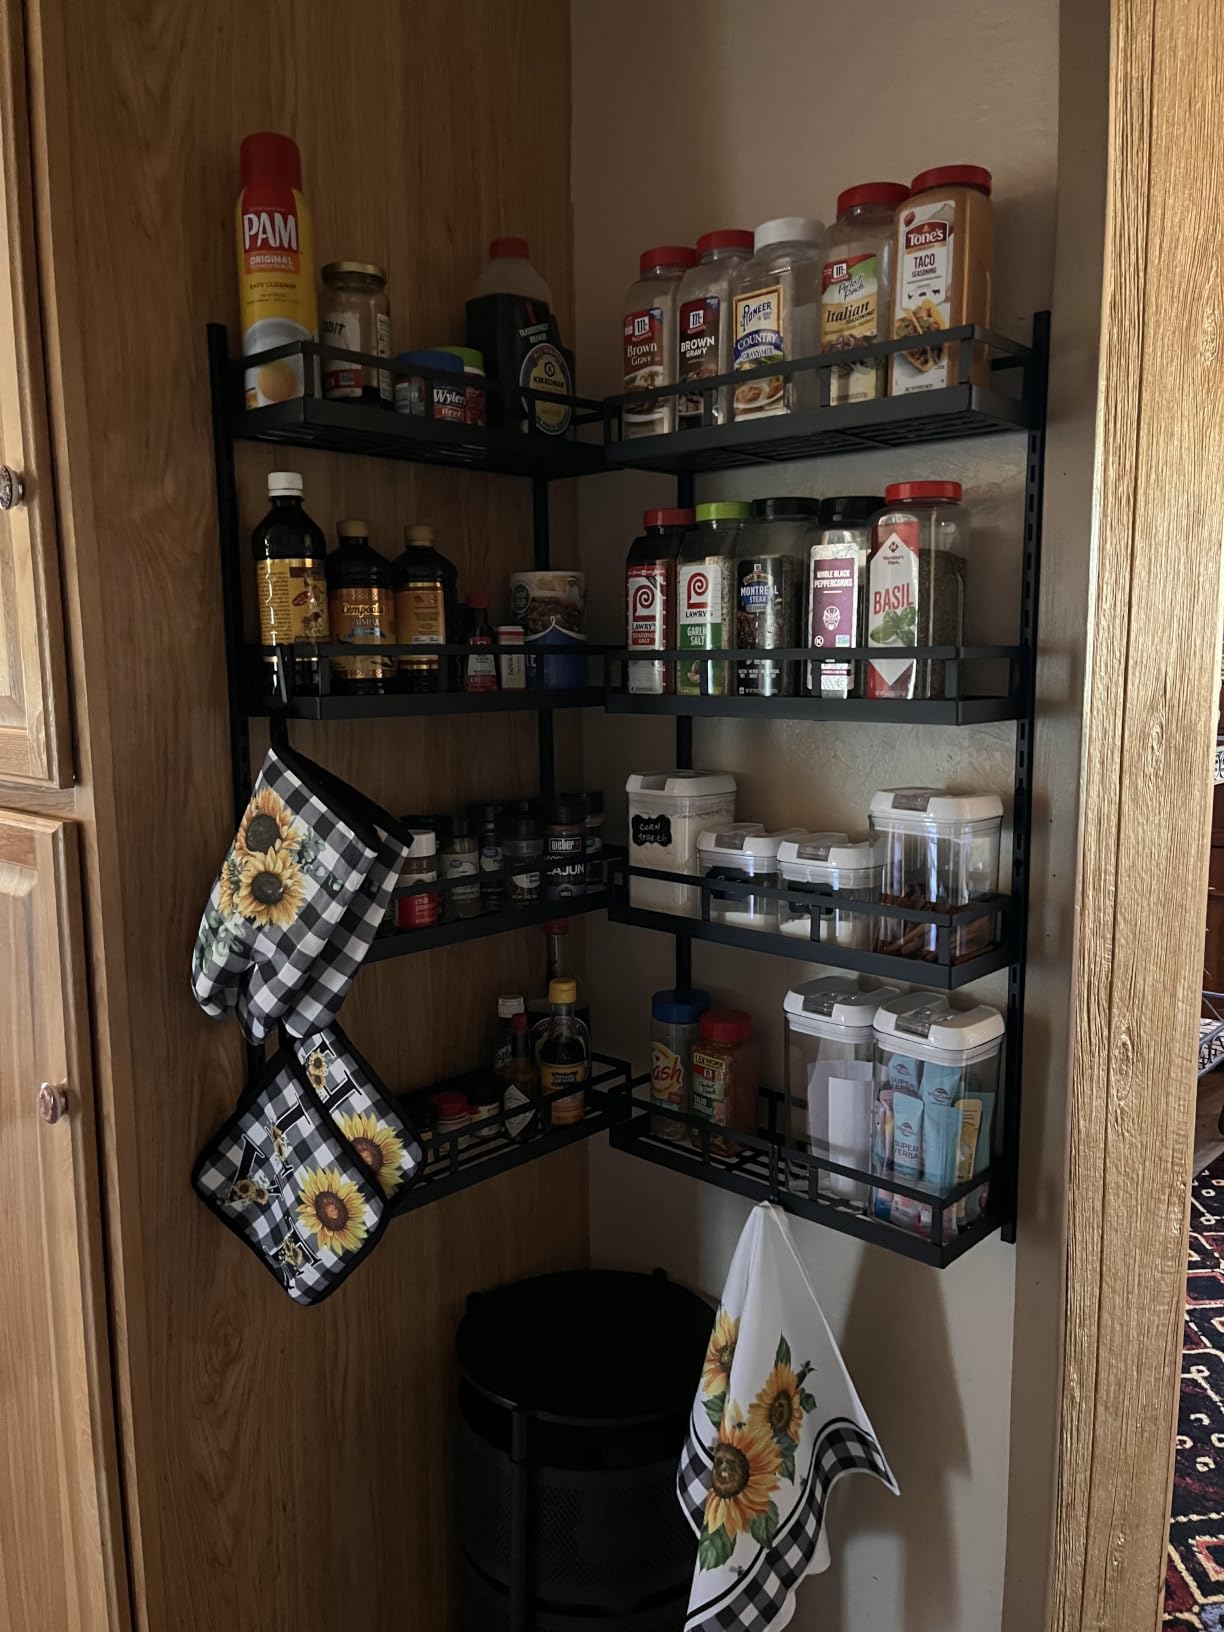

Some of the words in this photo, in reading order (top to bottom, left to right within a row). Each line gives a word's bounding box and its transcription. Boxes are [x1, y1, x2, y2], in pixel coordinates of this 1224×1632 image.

[243, 211, 298, 252] PAM
[908, 228, 944, 247] Tone's
[249, 255, 294, 266] ORIGINAL
[913, 253, 936, 269] TACO
[911, 267, 937, 278] SEASONING
[741, 302, 772, 332] PIONEER
[826, 301, 870, 323] Italian
[680, 336, 715, 353] BROWN
[737, 332, 778, 351] COUNTRY
[627, 343, 657, 358] Brown
[686, 347, 707, 359] GRAVY
[631, 355, 653, 367] Gravy
[432, 388, 467, 405] Wyler
[834, 569, 850, 578] BLACK
[814, 578, 853, 588] PEPPERCORNS
[740, 585, 779, 597] MONTREL
[873, 582, 915, 615] BASIL
[687, 626, 711, 637] GARLI
[690, 635, 706, 646] SALT
[546, 863, 585, 876] AJUN
[893, 1139, 919, 1153] SUPER
[893, 1147, 920, 1160] YERBA
